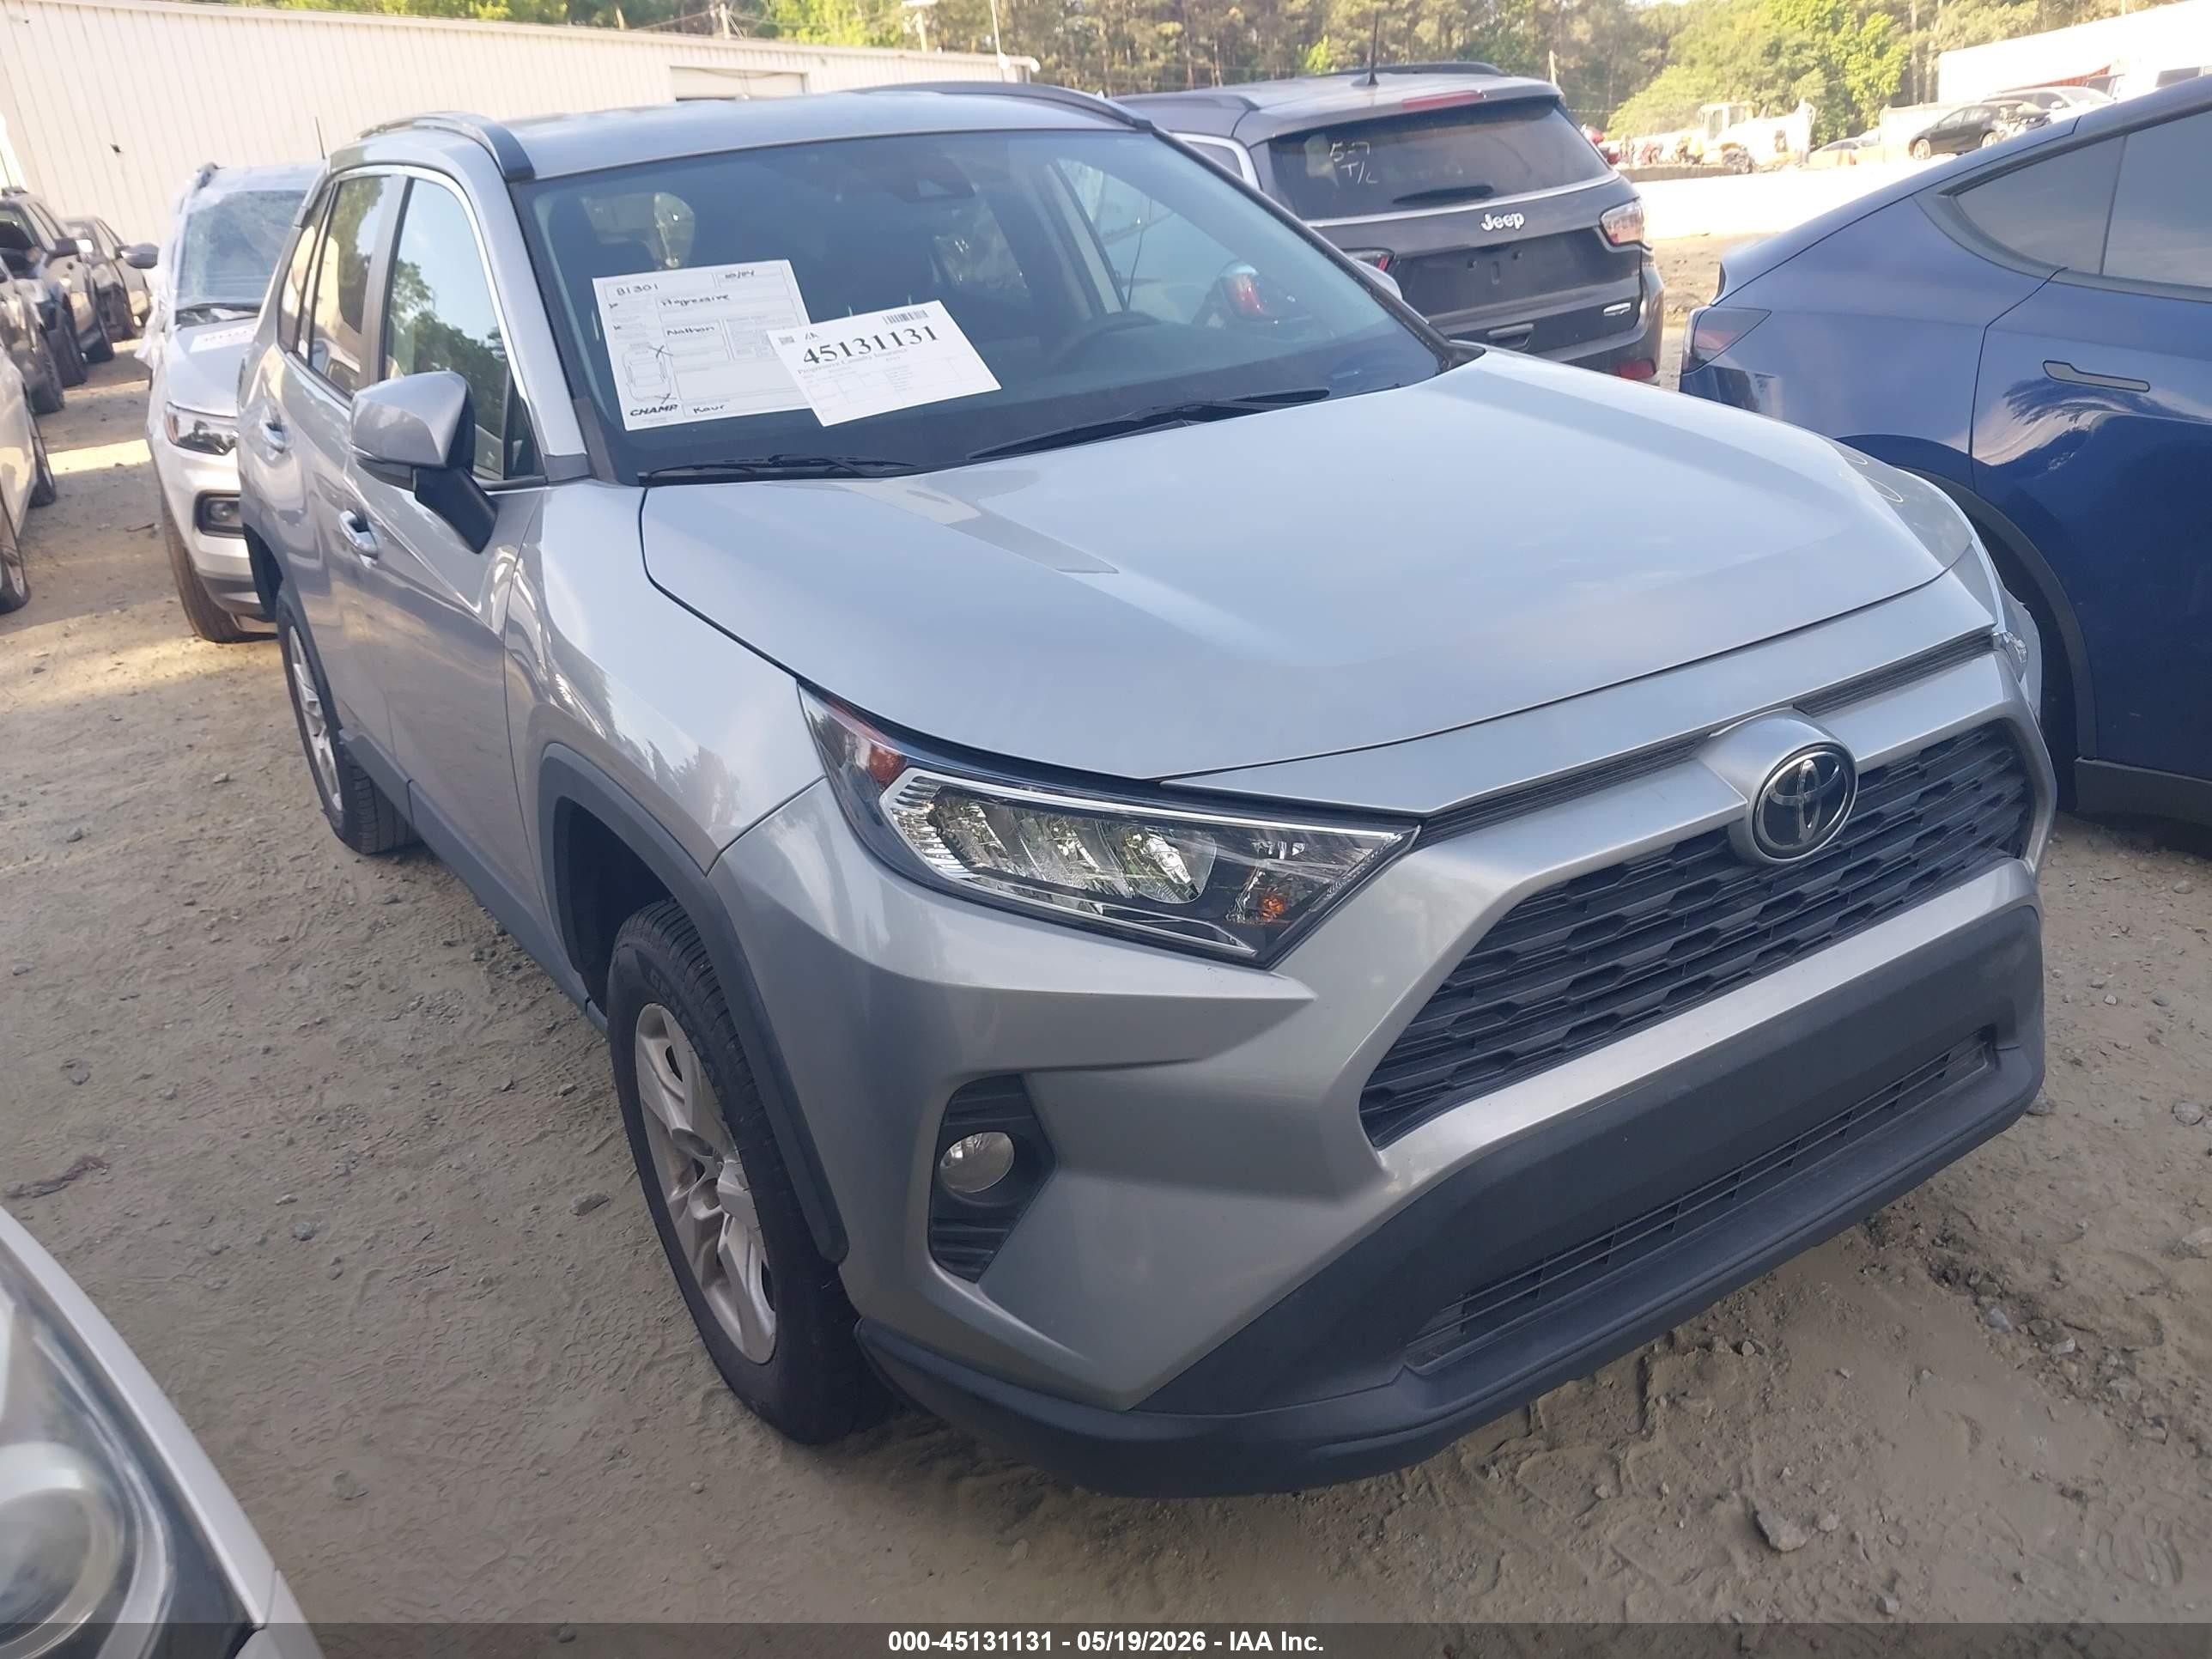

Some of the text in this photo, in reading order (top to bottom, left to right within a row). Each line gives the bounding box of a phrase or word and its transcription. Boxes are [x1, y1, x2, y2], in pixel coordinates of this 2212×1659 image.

[1480, 212, 1526, 232] Jeep
[803, 325, 939, 365] 45131131
[629, 404, 678, 417] CHAMP
